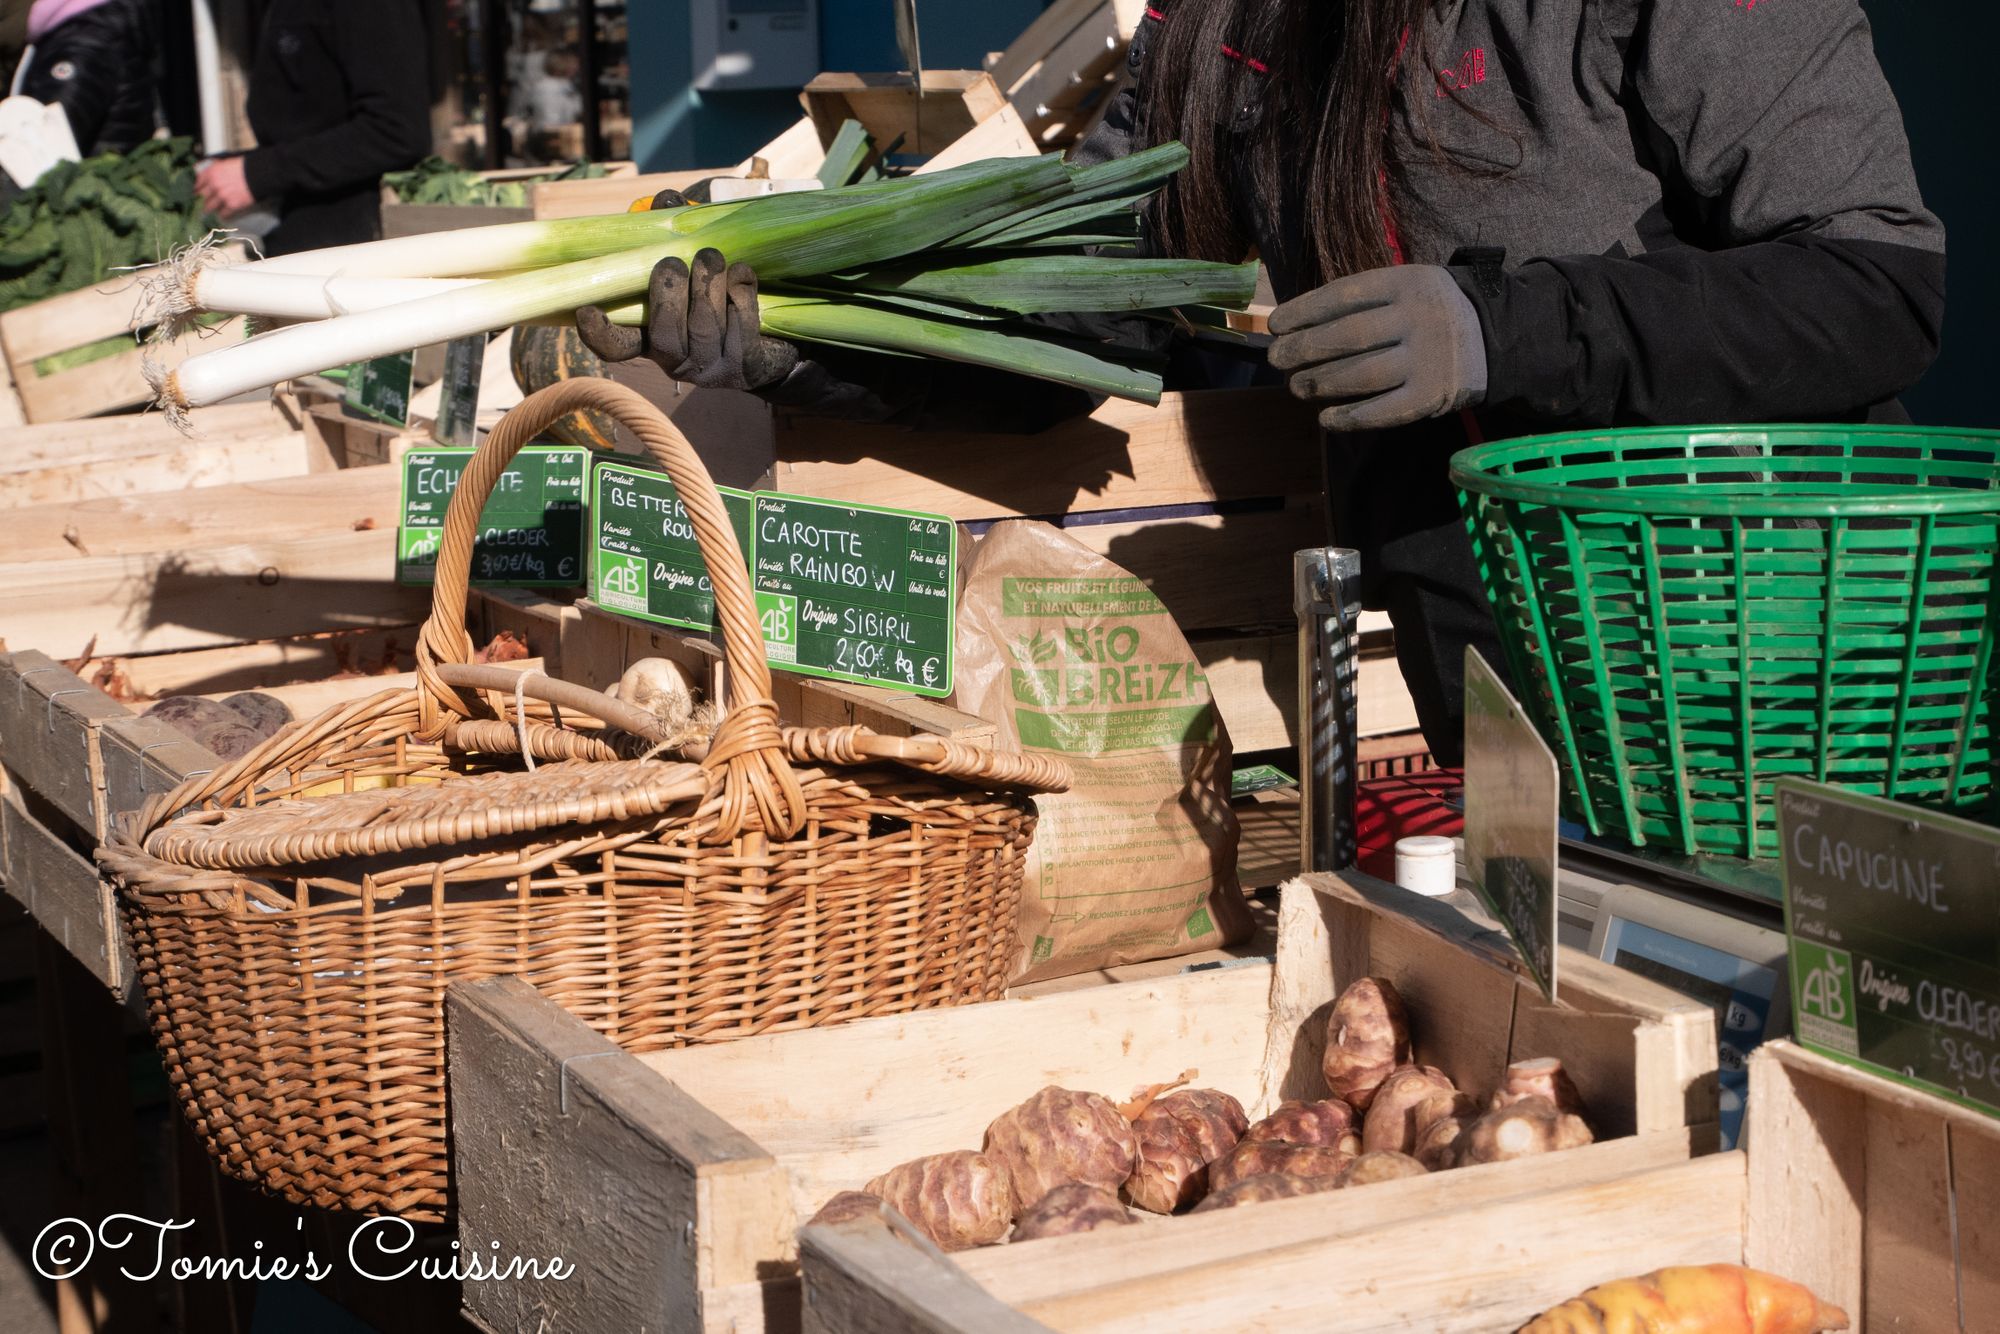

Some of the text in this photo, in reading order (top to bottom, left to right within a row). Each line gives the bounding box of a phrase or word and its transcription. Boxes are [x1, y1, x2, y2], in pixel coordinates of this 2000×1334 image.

[417, 468, 523, 494] ECHTE
[602, 471, 635, 486] Produit
[572, 488, 579, 496] €
[611, 487, 689, 519] BETTER
[758, 500, 786, 513] Produit
[603, 521, 632, 536] Variété
[663, 518, 697, 540] ROU
[761, 516, 863, 558] CAROTTE
[407, 540, 436, 565] AB
[601, 536, 642, 552] Traité au
[557, 556, 574, 578] €
[758, 558, 784, 573] Variété
[938, 569, 946, 579] €
[603, 565, 639, 594] AB
[653, 563, 694, 590] Origine
[758, 576, 792, 591] Traité au
[1015, 580, 1150, 594] VOS FRUITS ET LÉGUM
[802, 599, 838, 631] Origine
[1023, 601, 1037, 614] ET
[1040, 600, 1136, 614] NATURELLEMENT
[1138, 600, 1151, 611] DE
[760, 609, 790, 641] AB
[895, 649, 914, 684] kg
[921, 656, 940, 687] €
[1061, 712, 1170, 728] PRODUIRE SELON LE MODE
[1130, 722, 1182, 734] BIOLOGIQUE
[1126, 738, 1141, 747] PAS
[1793, 824, 1949, 913] CAPUCINE
[1802, 968, 1846, 1021] AB
[1859, 960, 1911, 1012] Origine
[1730, 1006, 1746, 1027] kg
